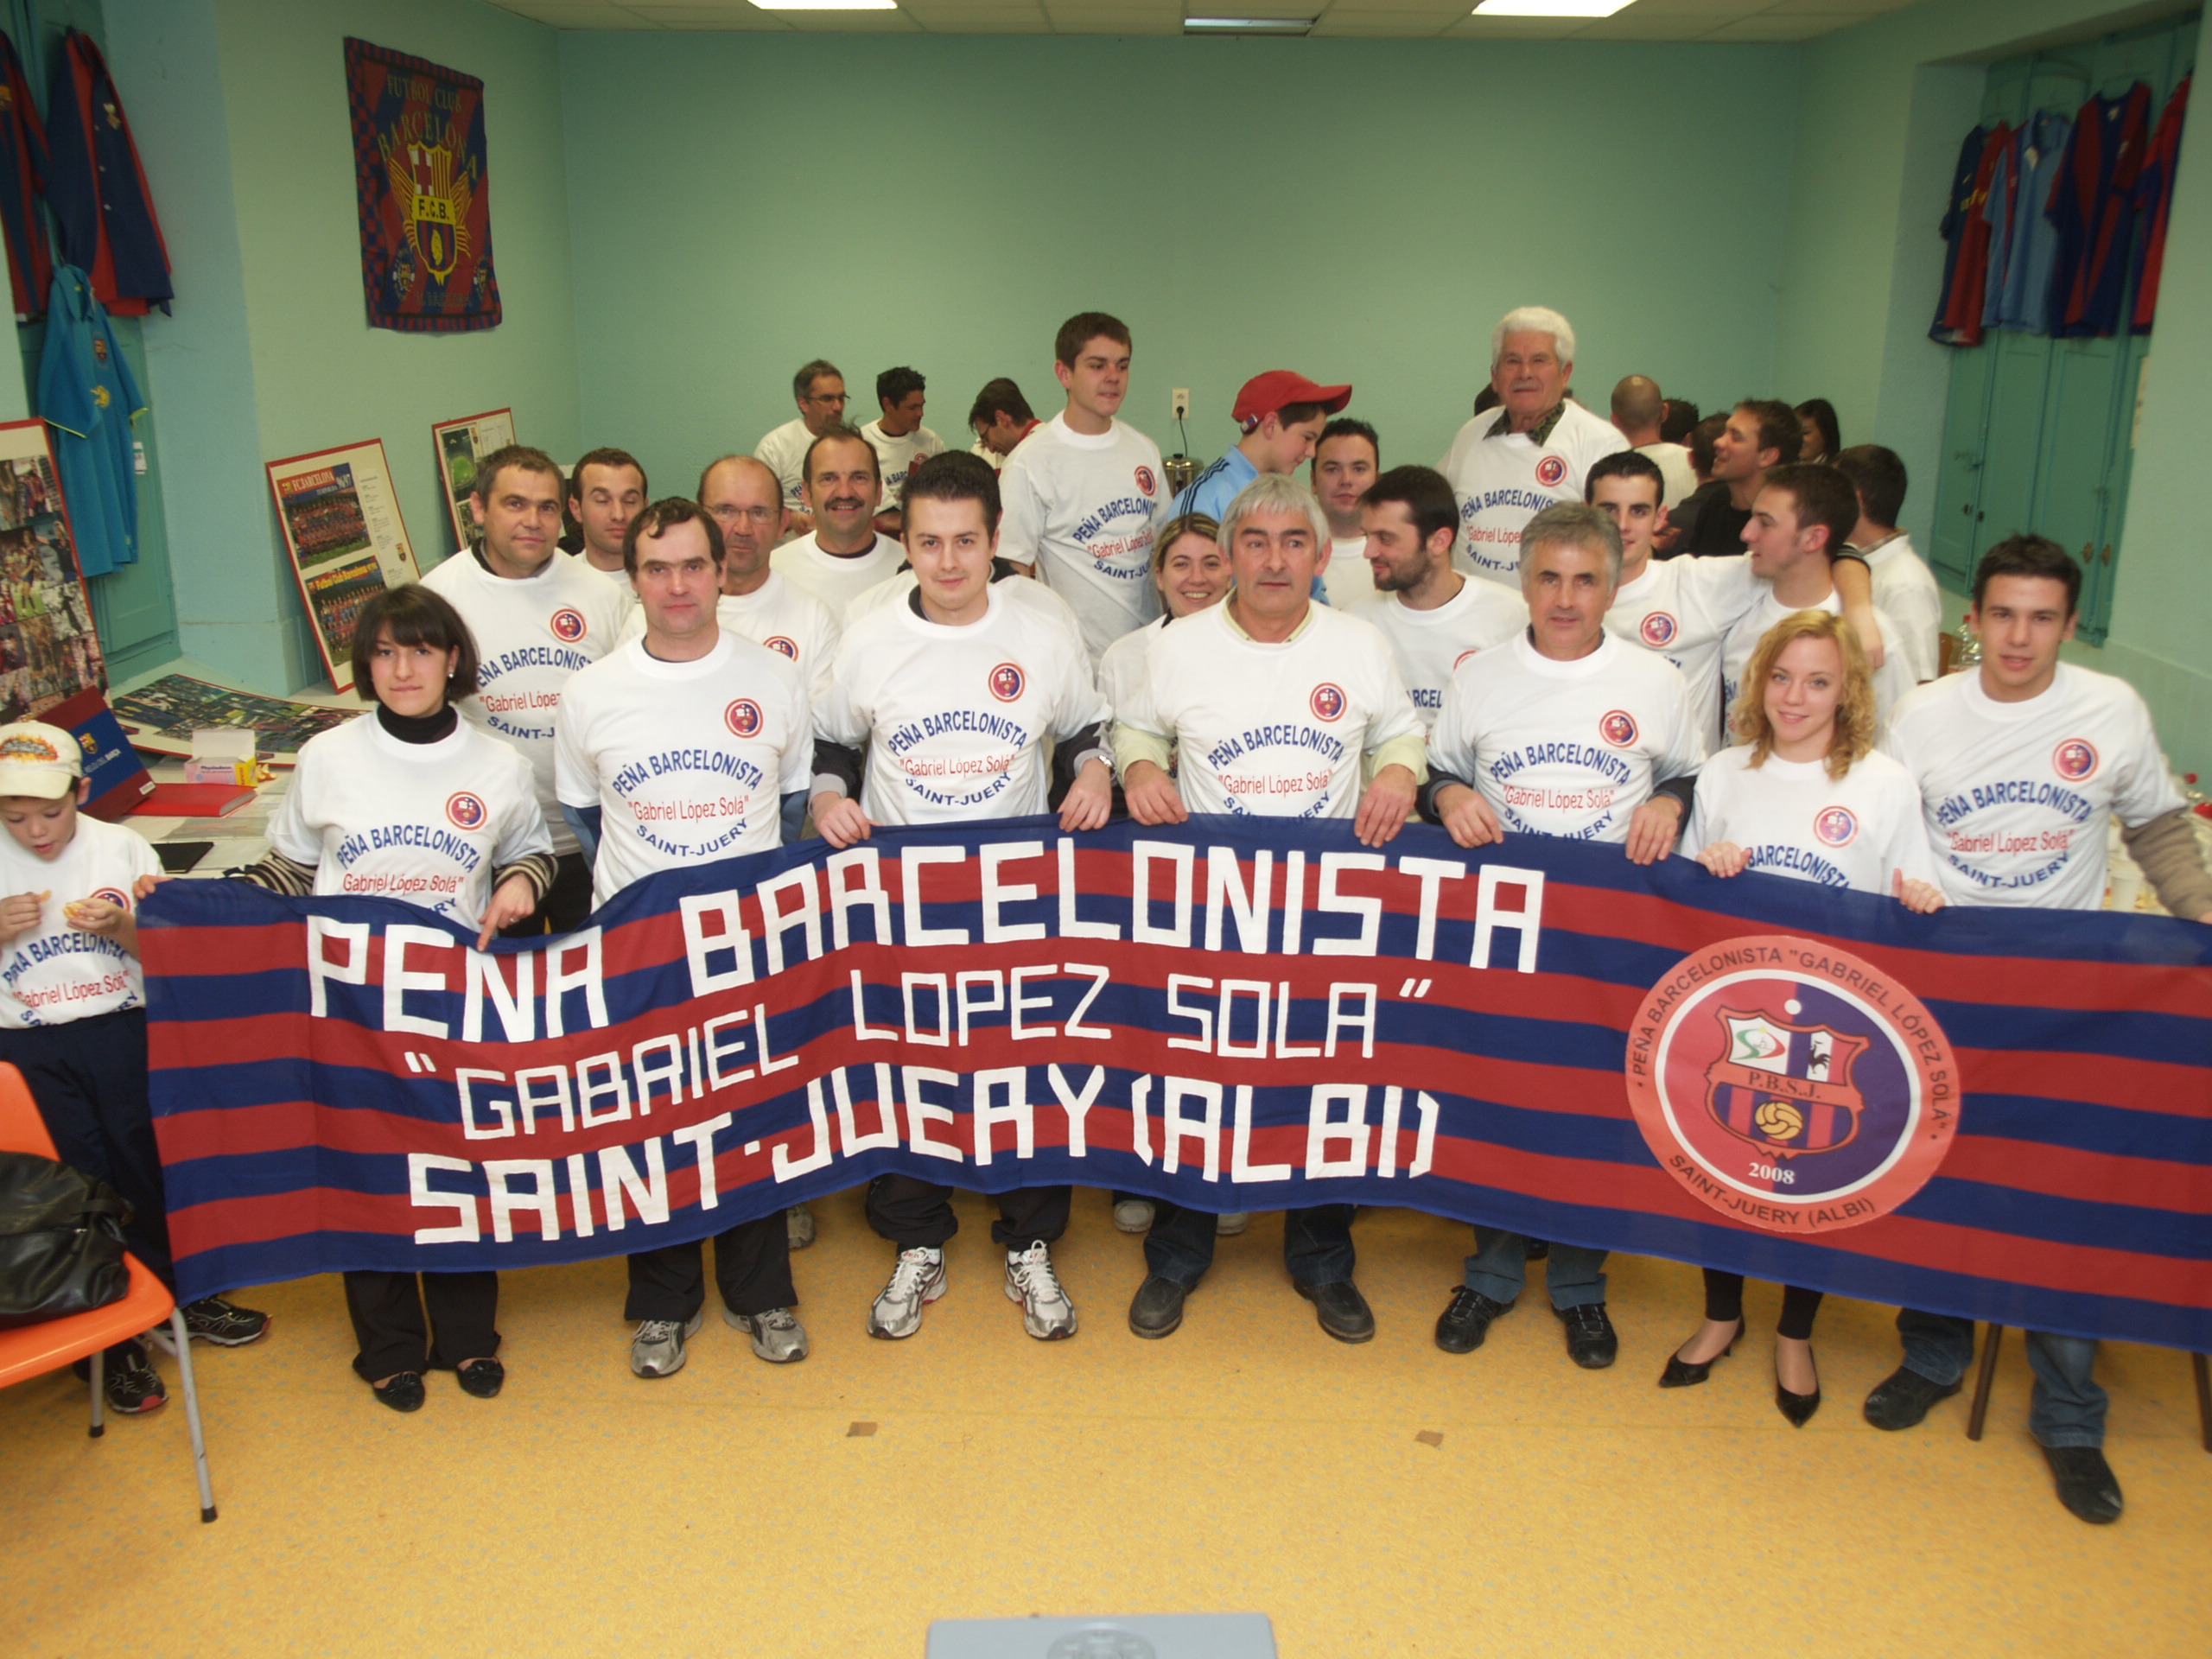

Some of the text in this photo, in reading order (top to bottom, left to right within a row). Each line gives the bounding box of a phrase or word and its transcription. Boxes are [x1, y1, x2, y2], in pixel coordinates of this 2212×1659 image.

[378, 109, 477, 181] BARCELONA
[418, 199, 450, 220] F.C.B.
[1484, 489, 1554, 512] BARCELONIS
[1071, 517, 1103, 544] PEÑA
[1497, 527, 1522, 546] Lópe
[500, 647, 594, 671] BARCELONIS
[479, 693, 528, 713] "Gabriel
[888, 710, 1027, 757] PEÑA BARCELONISTA
[1207, 725, 1344, 771] PEÑA BARCELONISTA
[612, 749, 764, 798] PEÑA BARCELONISTA
[899, 759, 946, 776] "Gabriel
[950, 758, 982, 779] López
[1490, 742, 1631, 786] PEÑA BARCELONISTA
[906, 772, 1011, 806] SAINT-JUERY
[1218, 774, 1265, 794] "Gabriel
[1269, 774, 1303, 798] López
[1503, 785, 1615, 813] "Gabriel López Solá"
[627, 795, 749, 823] "Gabriel López Solá"
[1936, 781, 2093, 828] PEÑA BARCELONISTA
[336, 824, 481, 873] PEÑA BARCELONISTA
[636, 817, 748, 857] SAINT-JUERY
[1946, 831, 1994, 852] "Gabriel
[1998, 831, 2037, 857] López
[1948, 851, 2069, 888] SAINT-JUERY
[390, 873, 428, 896] López
[429, 874, 465, 893] Solá"
[307, 837, 1545, 1043] PENA BARCELONISTA
[63, 979, 103, 1002] López
[850, 962, 1111, 1046] LOPEZ
[1632, 947, 1954, 1129] PEÑA BARCELONISTA "GABRIEL LÓPEZ SOLÁ"
[1748, 1071, 1821, 1100] P.B.S.J.
[1747, 1161, 1796, 1185] 2008
[1669, 1154, 1875, 1228] SAINT-JUERY (ALBI)
